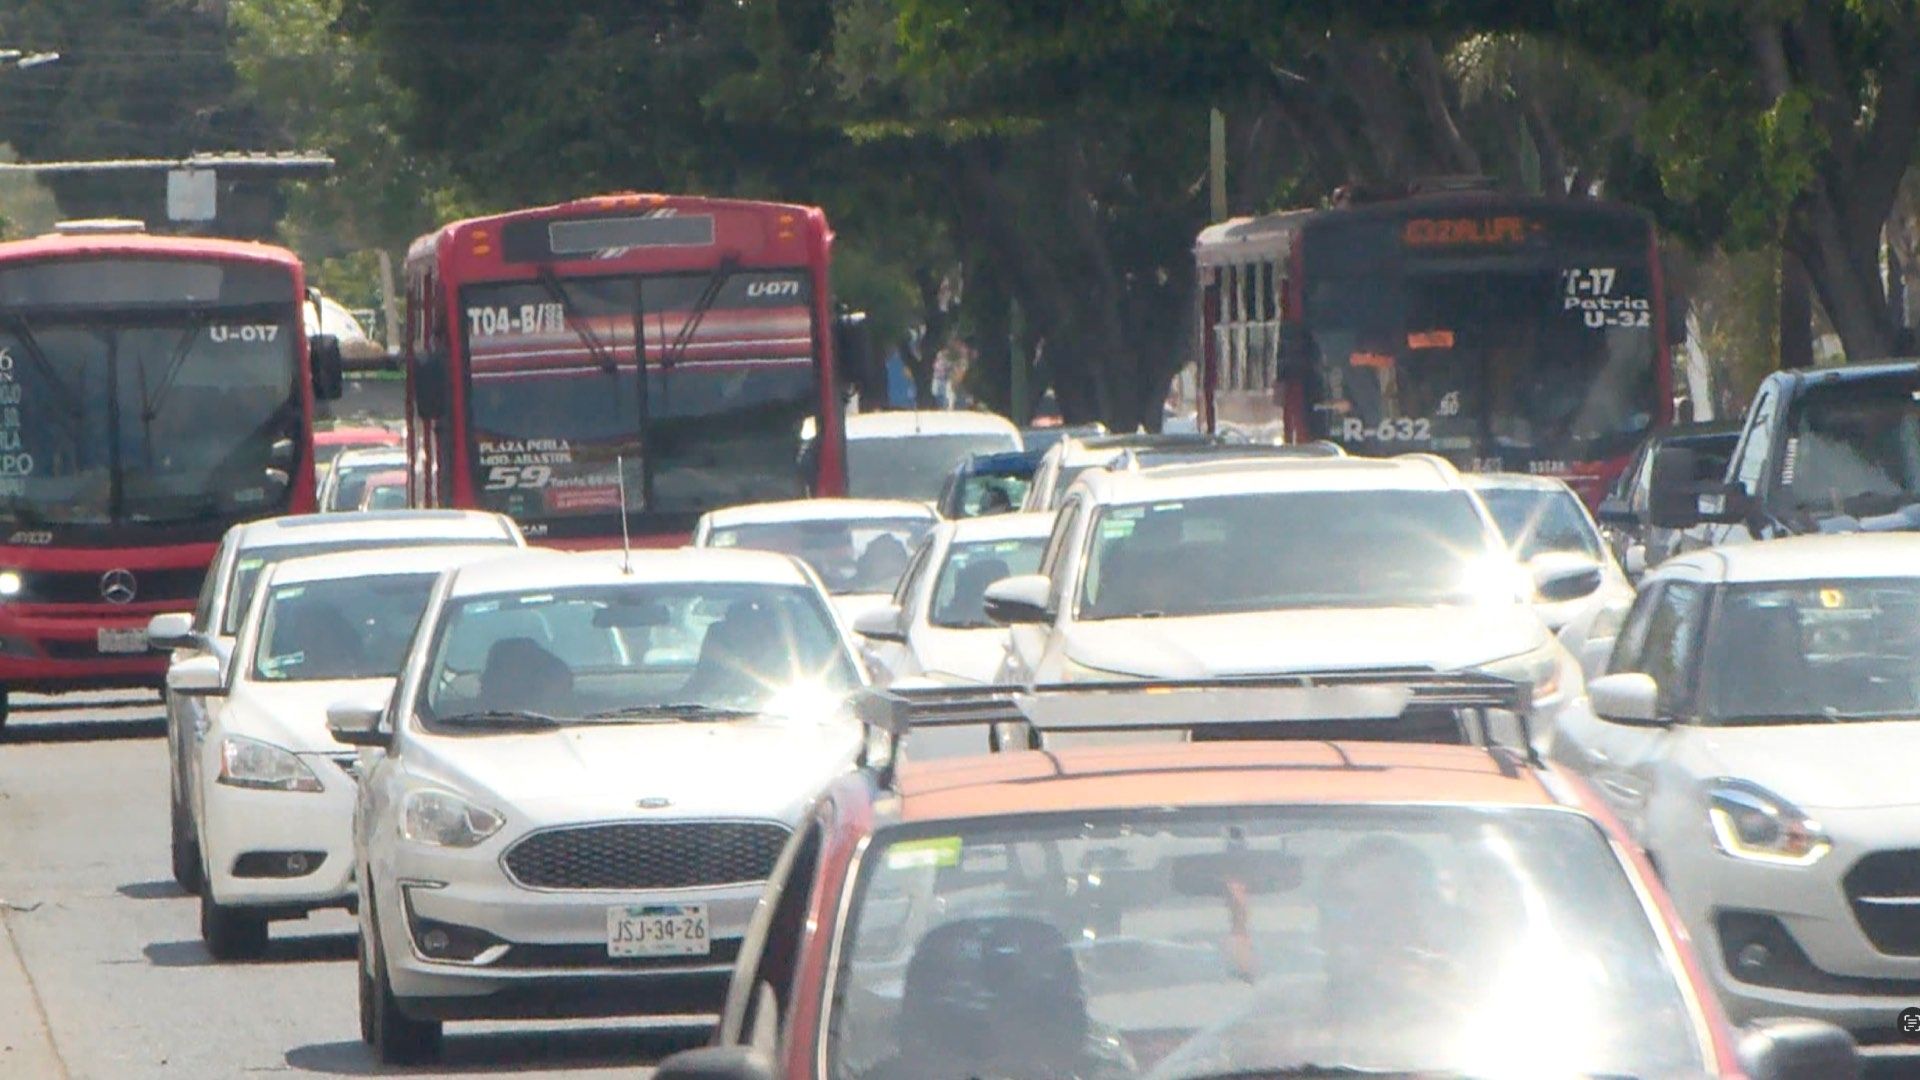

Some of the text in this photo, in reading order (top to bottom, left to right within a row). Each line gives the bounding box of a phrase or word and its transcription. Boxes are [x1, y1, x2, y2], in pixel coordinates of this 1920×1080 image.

[747, 280, 799, 296] U-071
[1564, 295, 1649, 310] Patria
[1584, 310, 1650, 328] U-32
[210, 324, 279, 342] U-017
[1342, 417, 1431, 442] R-632
[479, 441, 524, 453] PLAZA
[485, 466, 551, 490] 59
[612, 918, 705, 942] JSJ-34-26
